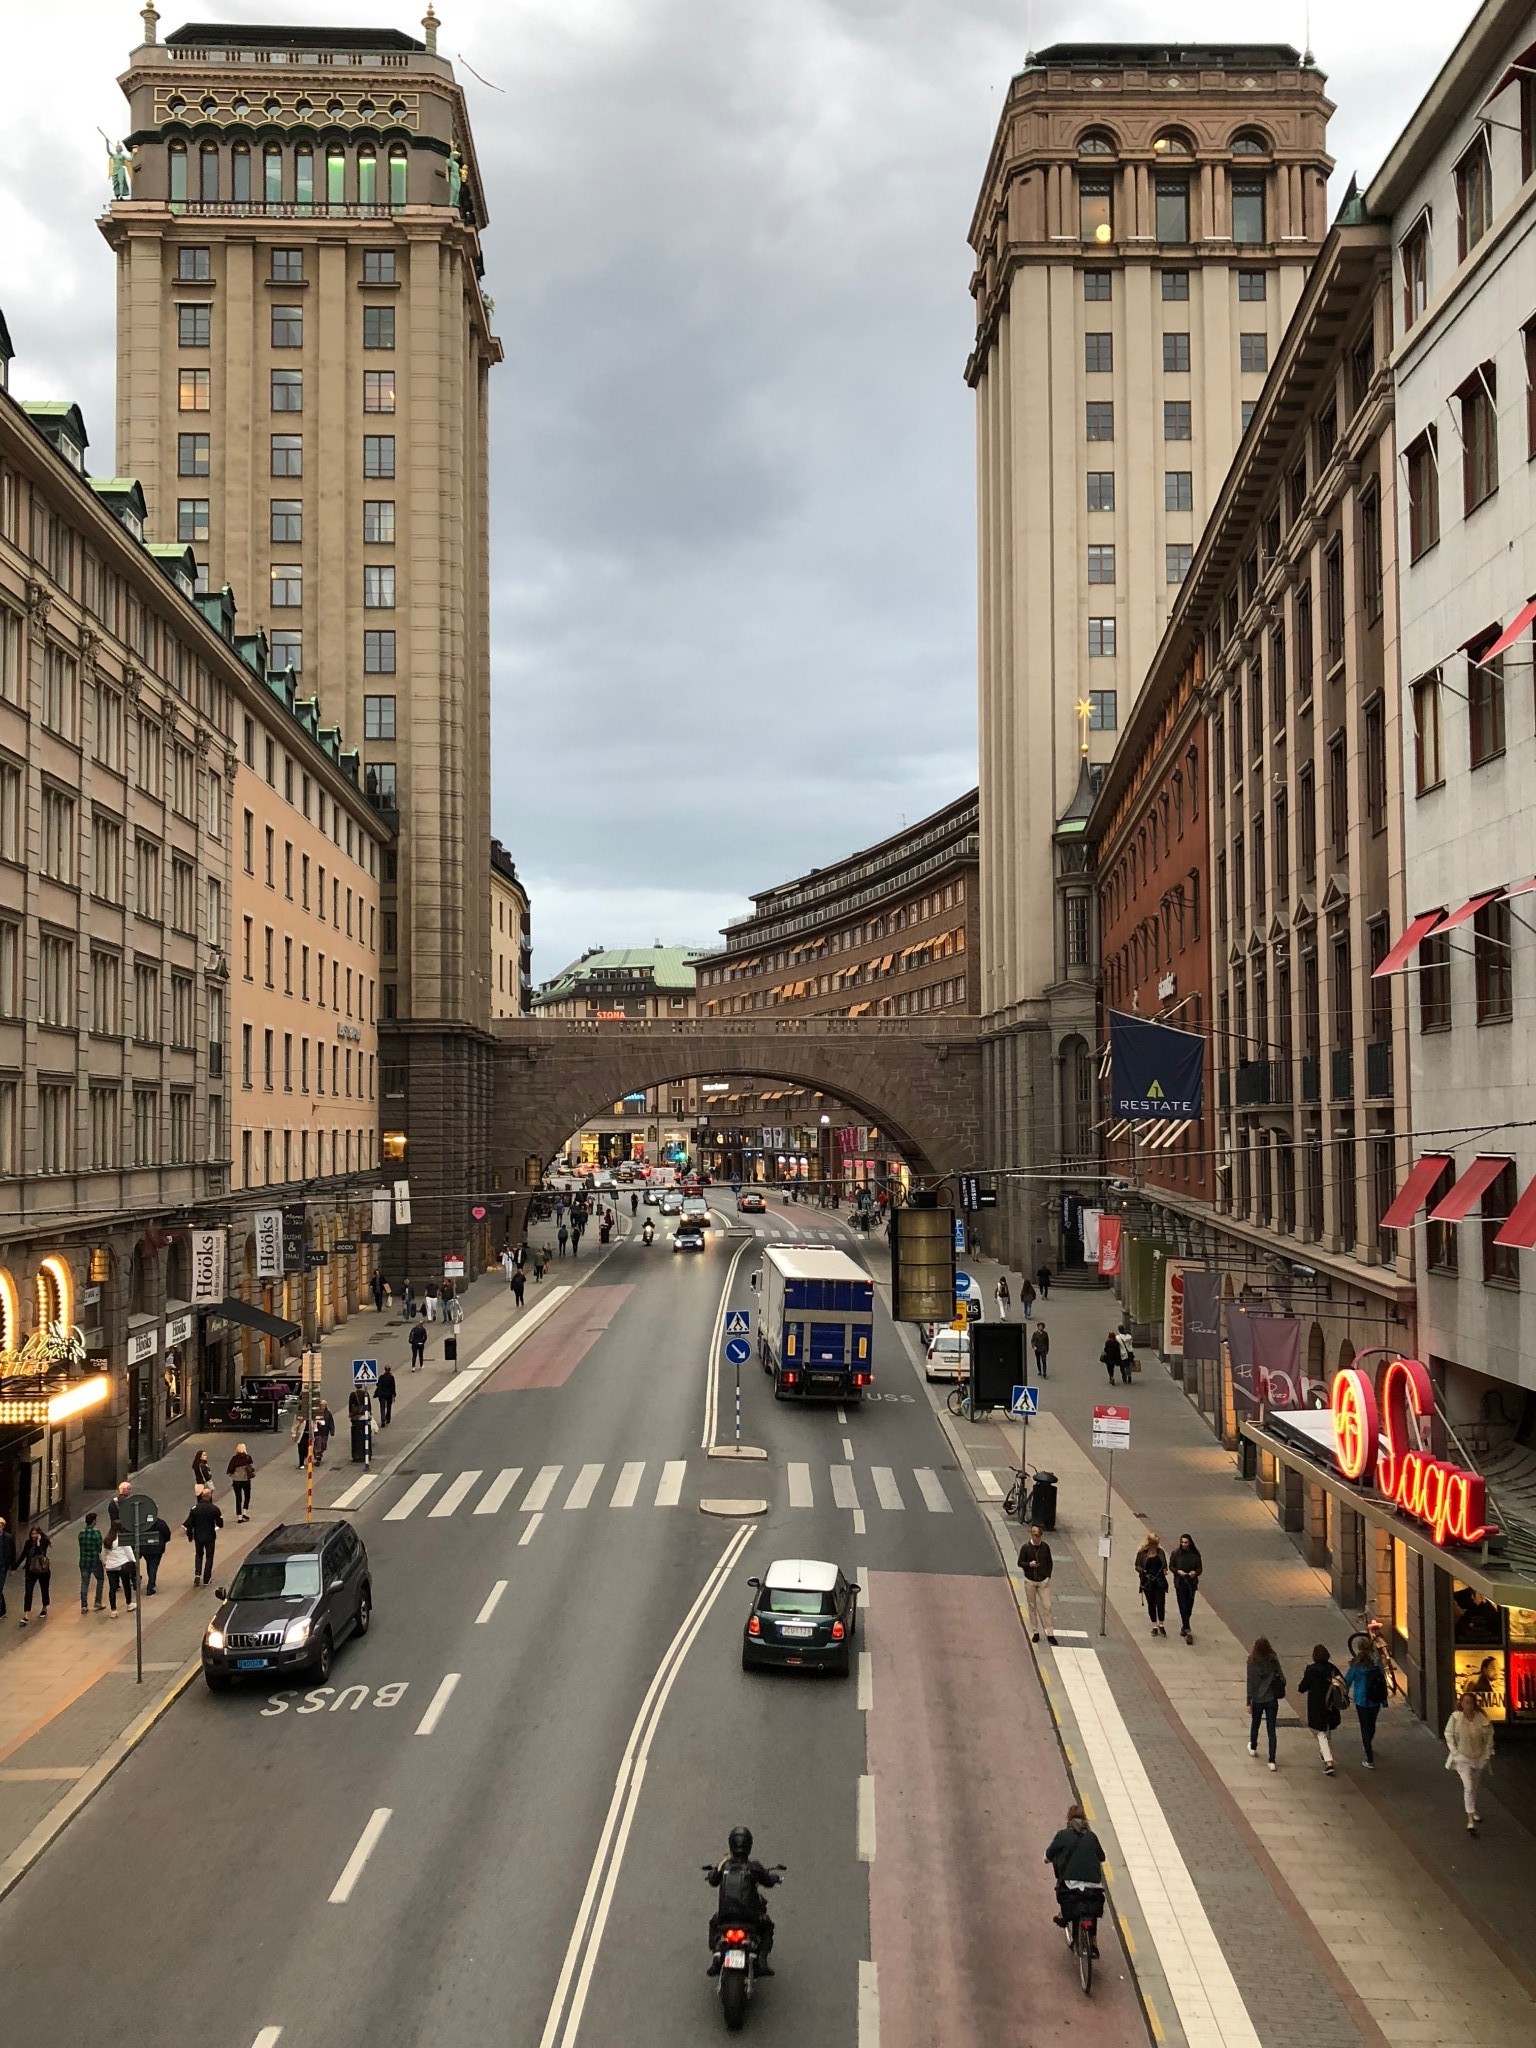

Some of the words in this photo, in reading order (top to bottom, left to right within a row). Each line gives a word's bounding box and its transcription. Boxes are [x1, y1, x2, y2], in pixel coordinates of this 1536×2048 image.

[1120, 1101, 1191, 1111] RESTATE
[970, 1179, 978, 1209] SAMSUNG
[259, 1216, 275, 1270] Hööks
[288, 1241, 297, 1252] &
[196, 1235, 214, 1298] Hööks
[866, 1393, 916, 1403] USS
[1377, 1360, 1498, 1546] Saga
[260, 1682, 409, 1716] BUSS
